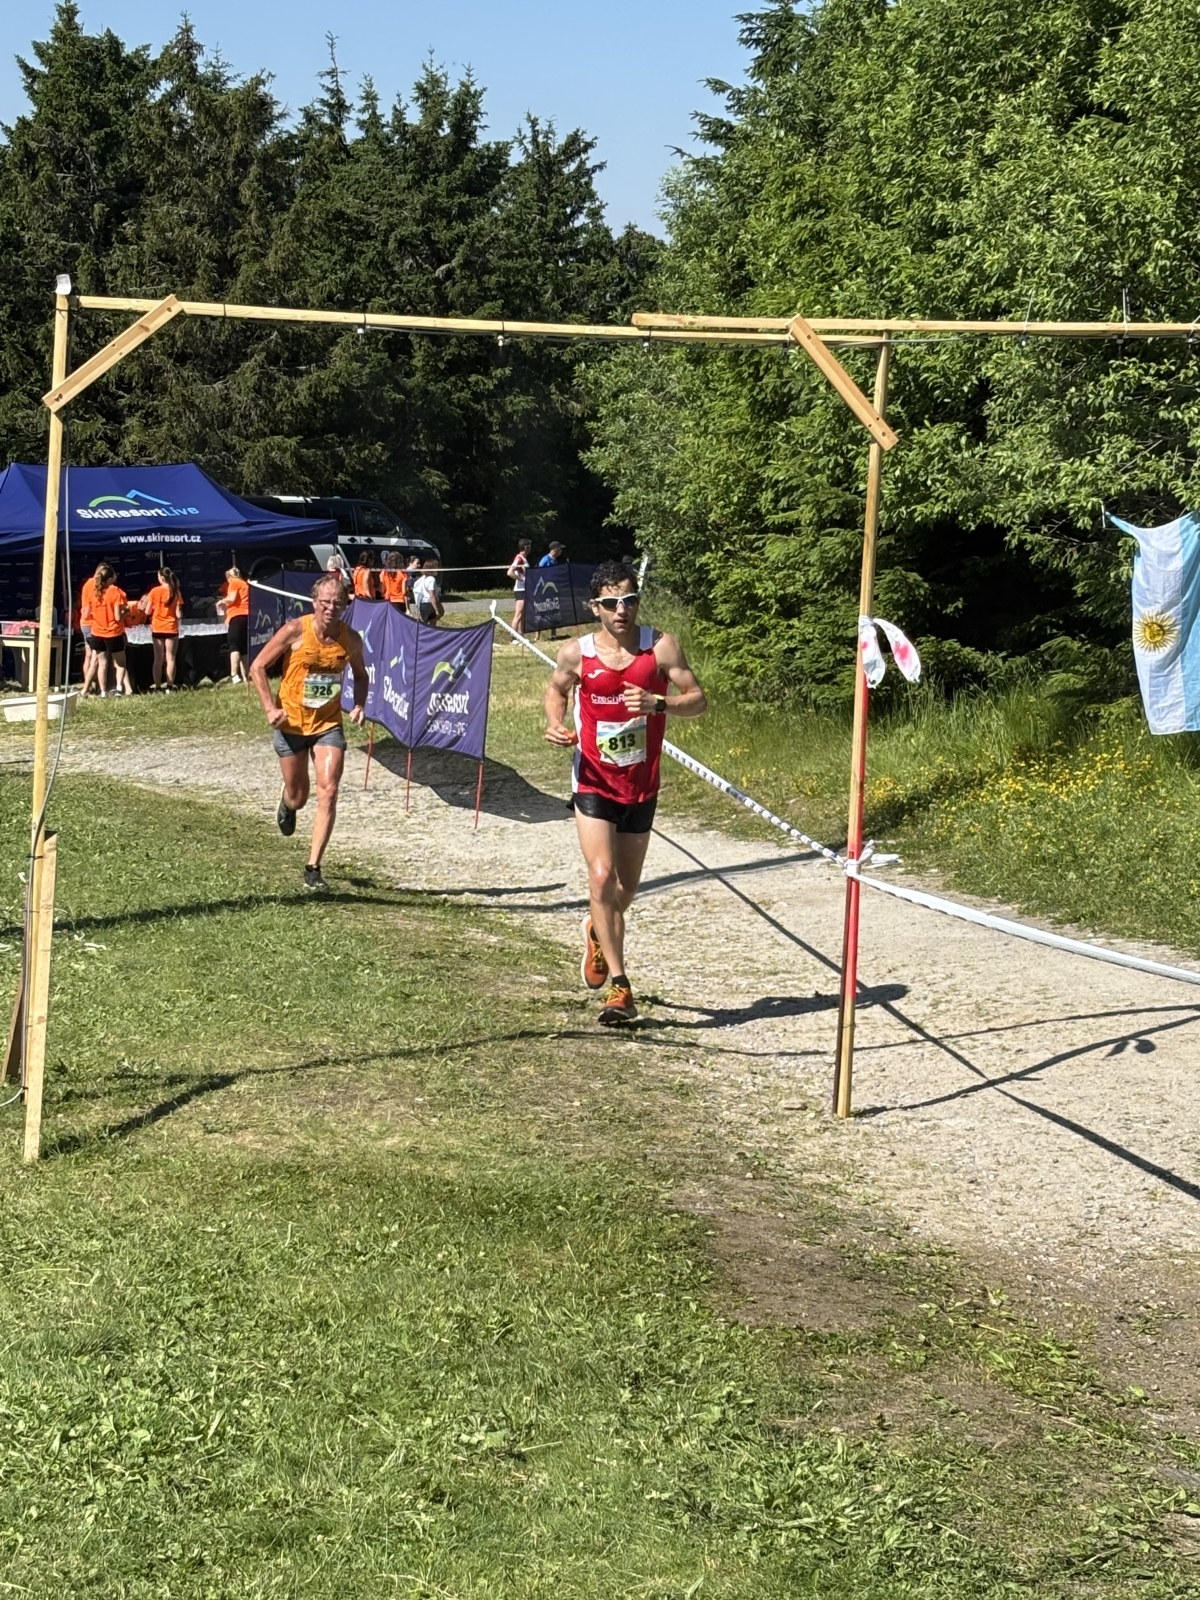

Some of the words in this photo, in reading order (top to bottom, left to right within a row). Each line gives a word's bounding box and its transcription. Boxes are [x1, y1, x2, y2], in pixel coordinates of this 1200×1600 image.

[120, 533, 202, 543] www.skiresort.cz
[312, 685, 333, 697] 926
[590, 693, 626, 704] CzechR
[608, 733, 637, 751] 813
